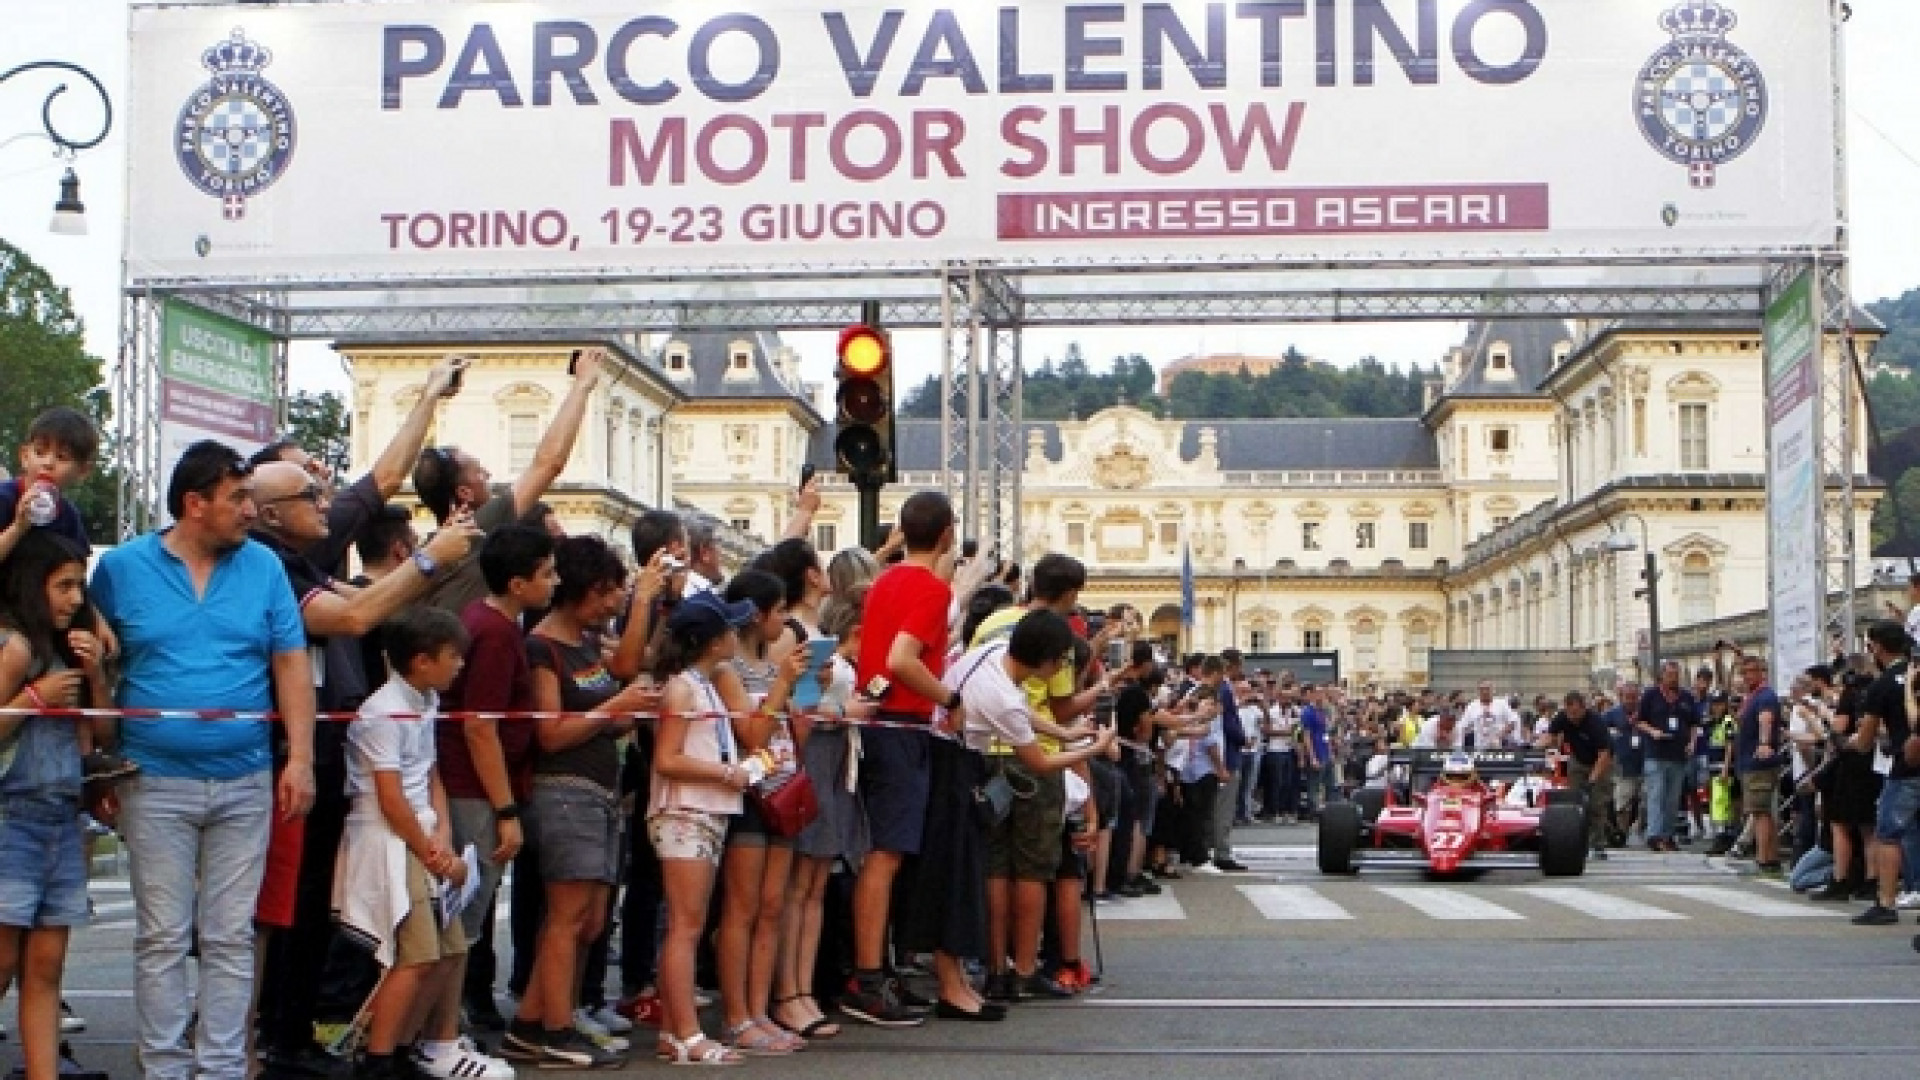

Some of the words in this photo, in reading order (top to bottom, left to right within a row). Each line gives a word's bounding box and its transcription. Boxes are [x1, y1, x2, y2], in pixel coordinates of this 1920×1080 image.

[381, 13, 779, 108] PARCO
[821, 0, 1548, 97] VALENTINO
[609, 108, 967, 187] MOTOR
[1000, 101, 1307, 177] SHOW
[381, 211, 580, 250] TORINO,
[600, 206, 723, 244] 19-23
[740, 200, 946, 241] GIUGNO
[1035, 198, 1296, 232] INGRESSO
[1316, 194, 1507, 227] ASCARI
